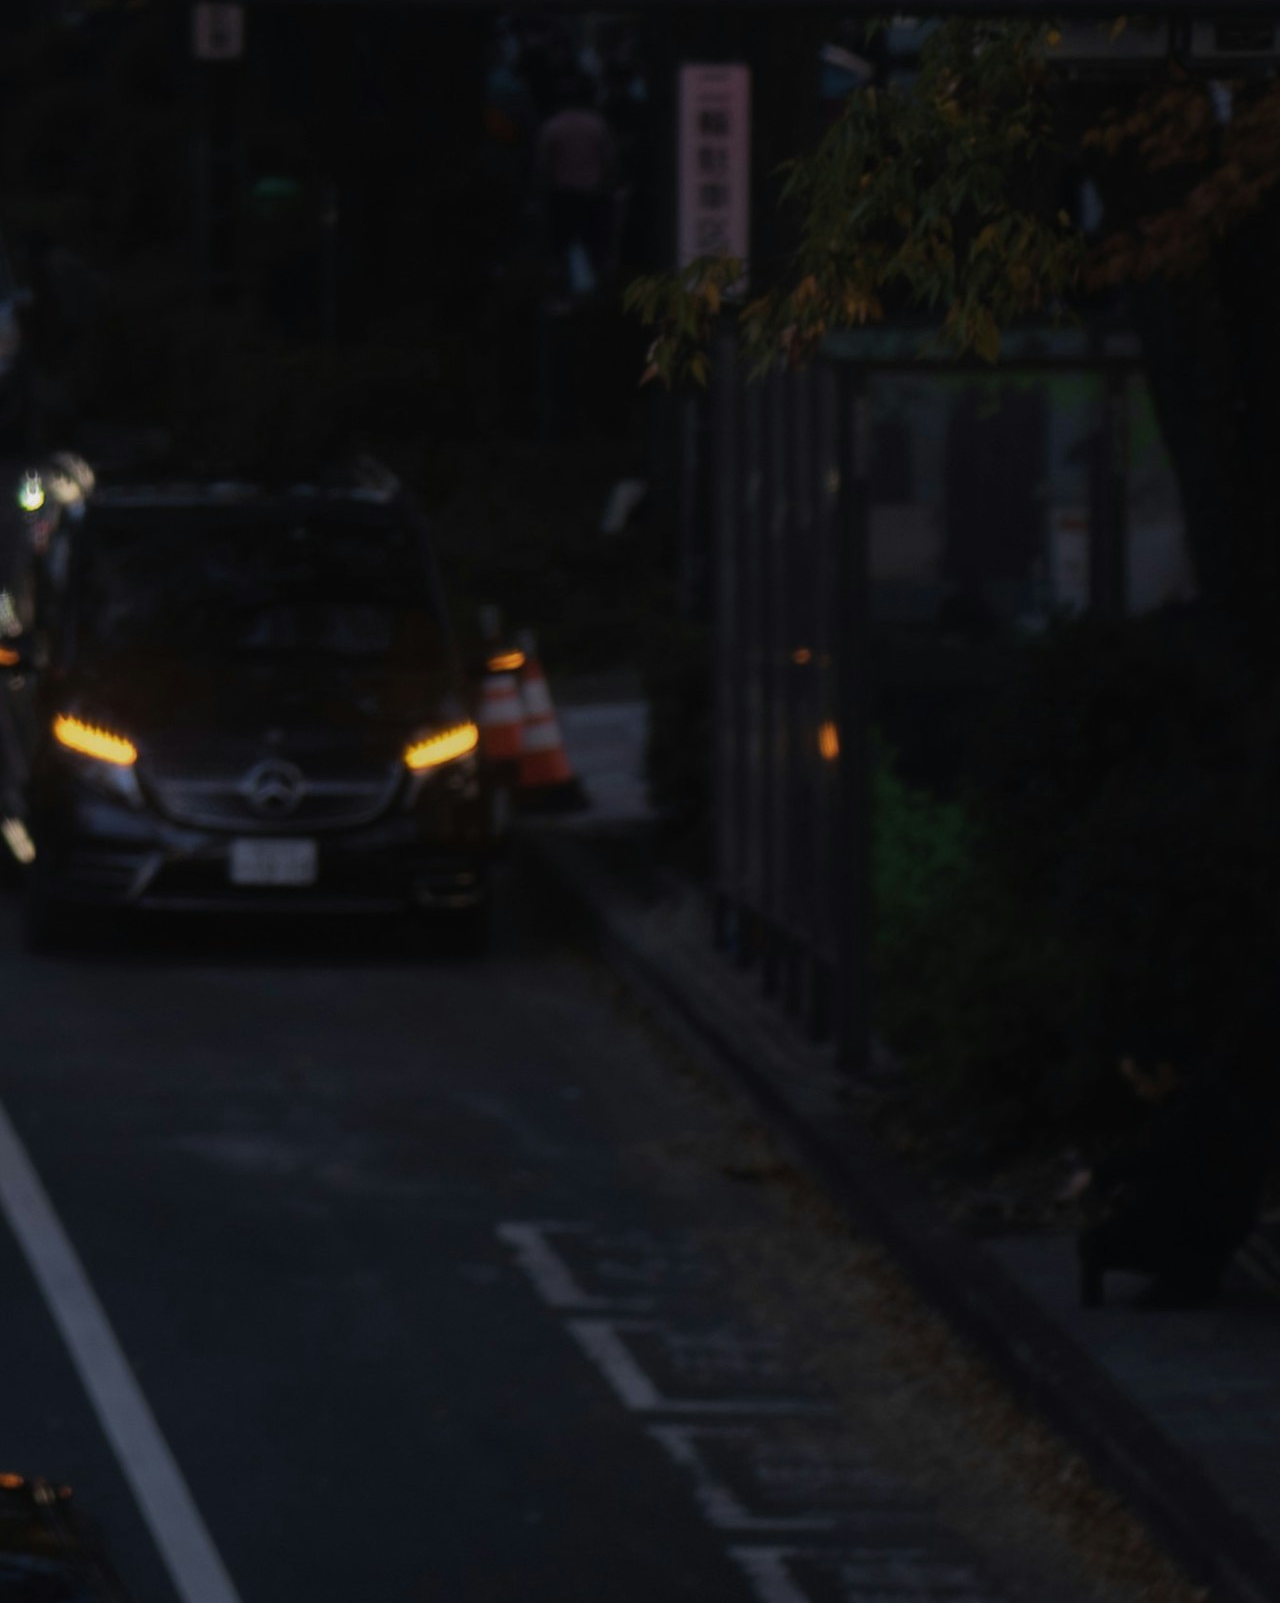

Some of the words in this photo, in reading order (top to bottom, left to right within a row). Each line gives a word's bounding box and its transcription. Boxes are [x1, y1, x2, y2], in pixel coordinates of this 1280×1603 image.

[695, 70, 731, 257] 二輪駐車区
